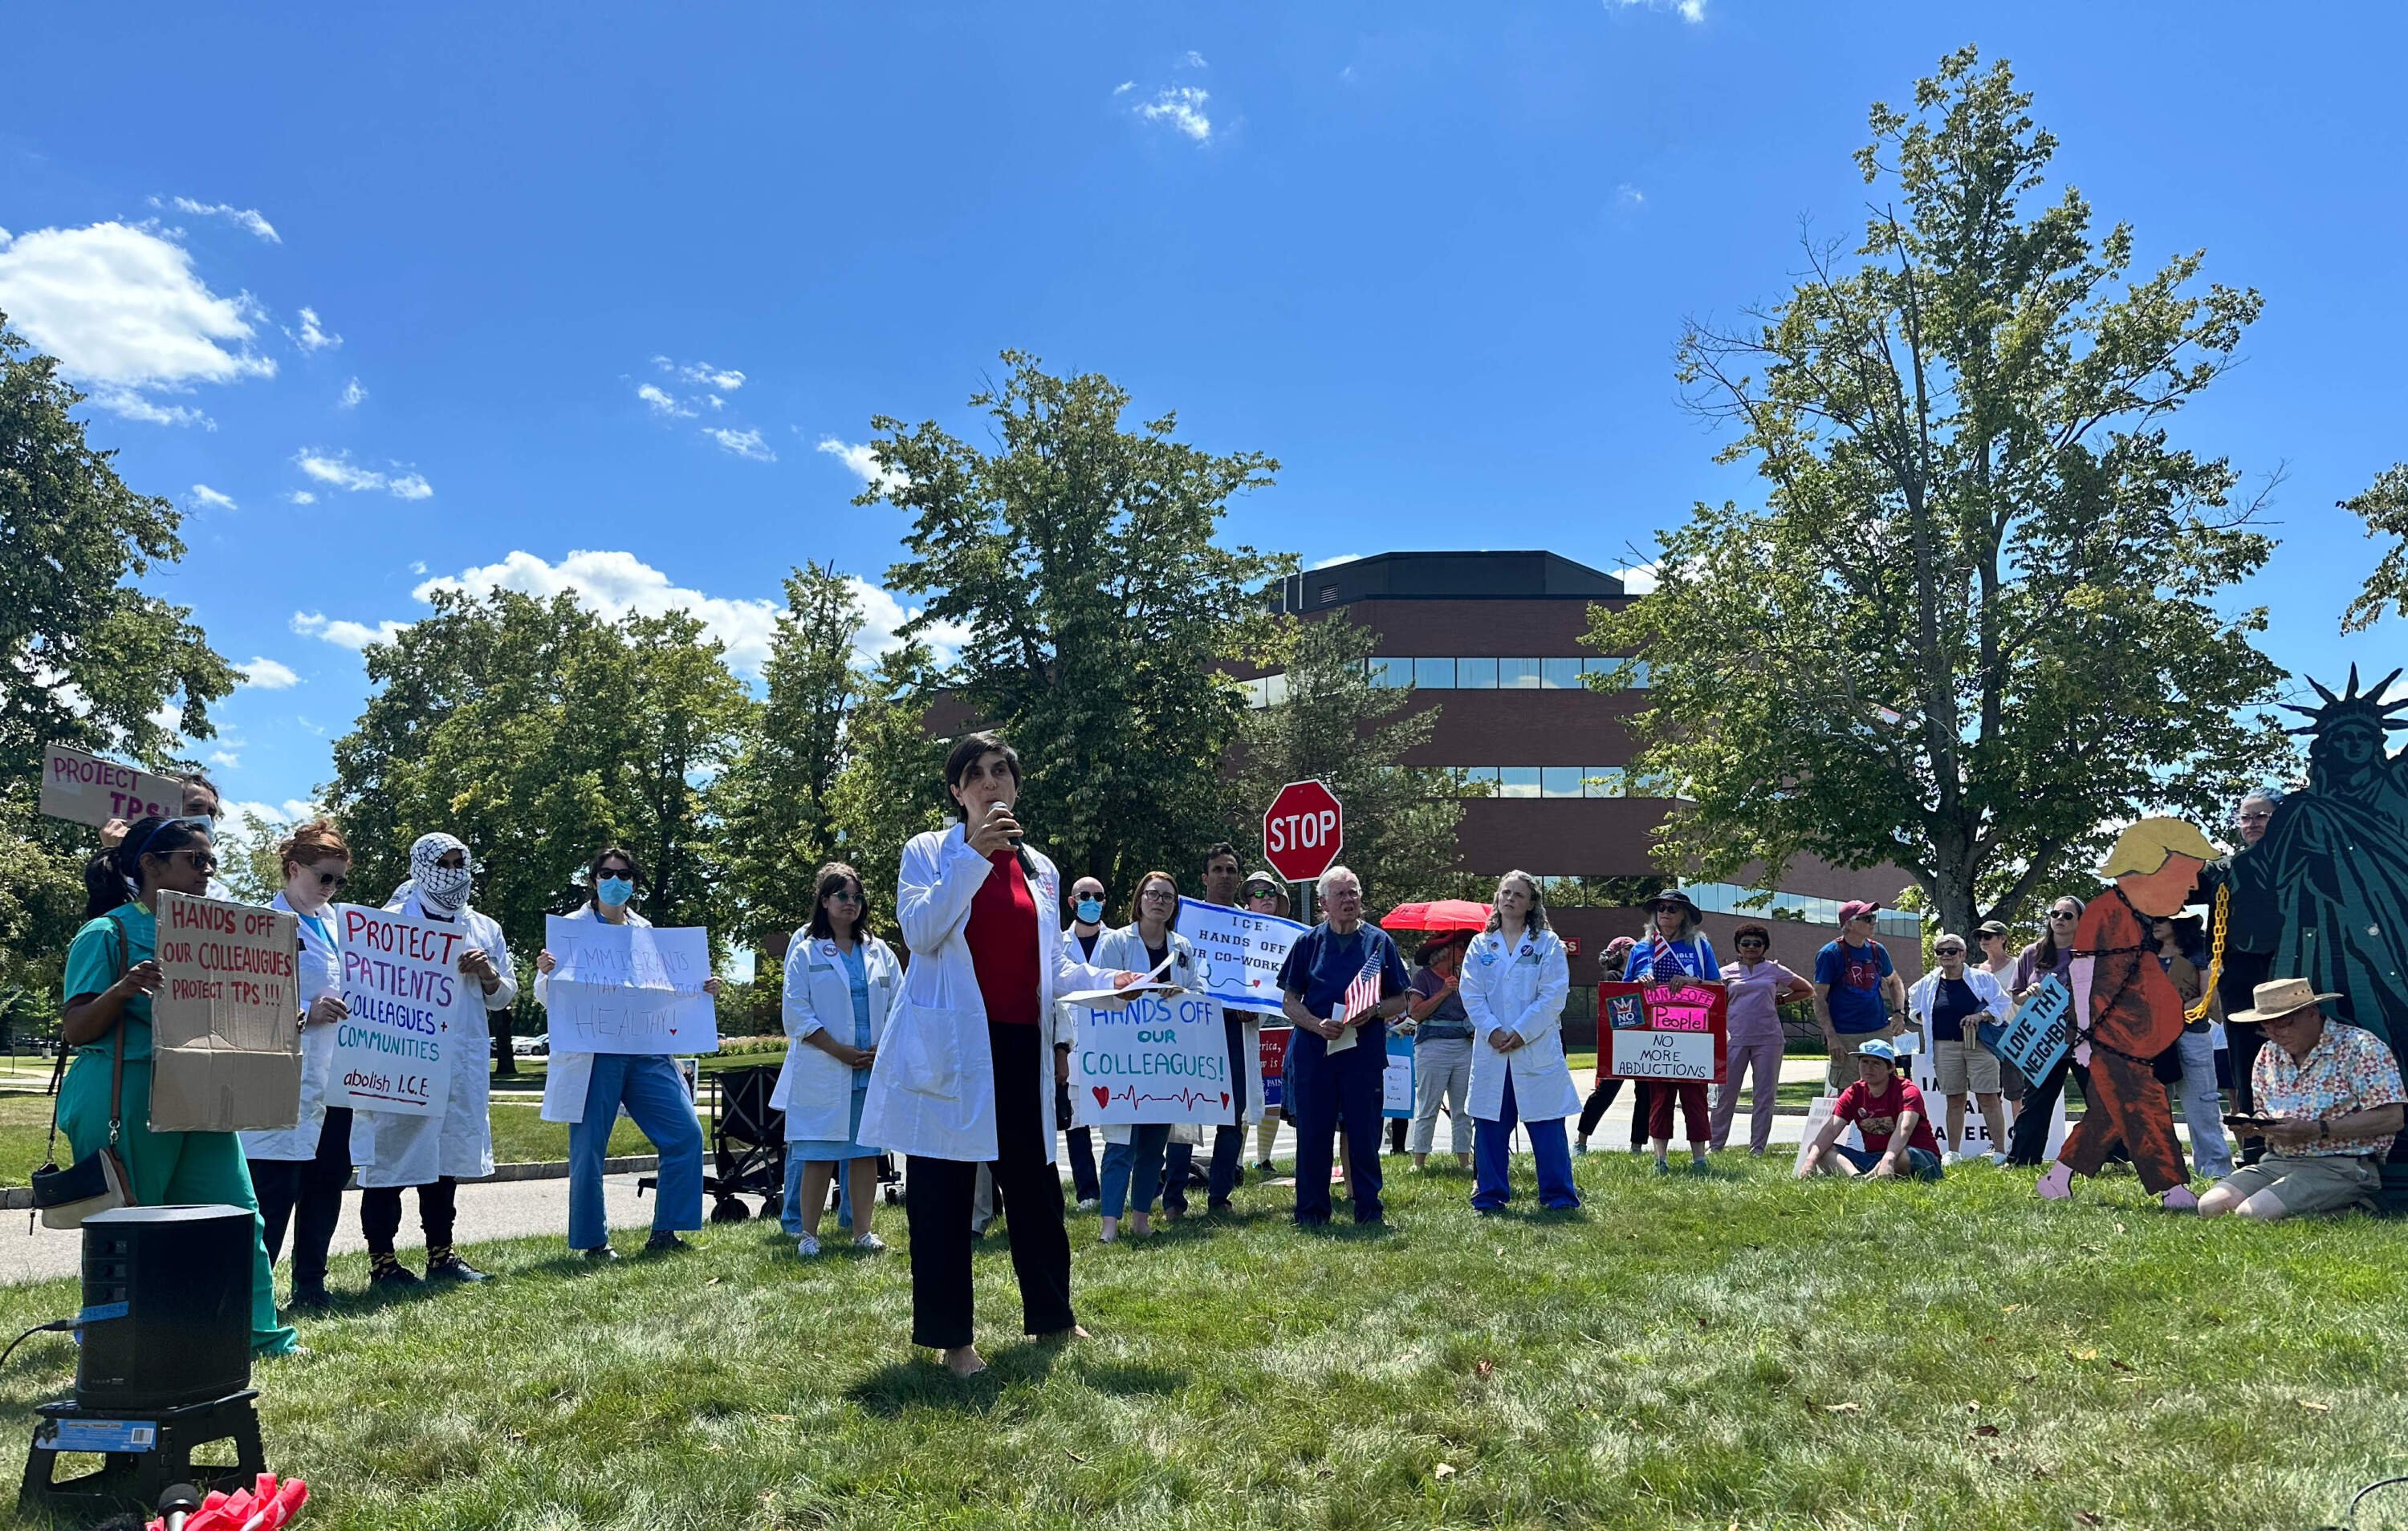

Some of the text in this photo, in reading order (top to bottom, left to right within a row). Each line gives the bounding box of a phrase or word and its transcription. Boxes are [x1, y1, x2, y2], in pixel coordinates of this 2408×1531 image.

[54, 757, 141, 791] PROTECT
[1270, 810, 1336, 852] STOP
[172, 900, 276, 938] HANDS OFF
[1232, 916, 1270, 932] ICE:
[346, 910, 463, 964] PROTECT
[1199, 929, 1287, 955] HANDS OFF
[163, 942, 292, 977] OUR COLLEAUGUES
[561, 936, 689, 974] IMMIGRANTS
[1214, 952, 1283, 973] CO-WORK
[173, 978, 223, 1001] PROTECT
[231, 981, 260, 1005] TPS
[344, 951, 454, 1007] PATIENTS
[341, 990, 436, 1035] COLLEAGUES
[1090, 998, 1214, 1027] HANDS OFF
[1617, 1012, 1635, 1023] NO
[2003, 983, 2062, 1060] LOVE THY
[338, 1024, 440, 1062] COMMUNITIES
[1137, 1029, 1178, 1044] OUR
[1652, 1034, 1674, 1048] NO
[1083, 1051, 1224, 1082] COLLEAGUES!
[1618, 1061, 1706, 1078] ABDUCTIONS
[1640, 1050, 1681, 1062] MORE
[344, 1068, 429, 1098] abolish I.C.E.
[1267, 1078, 1283, 1087] PAIN
